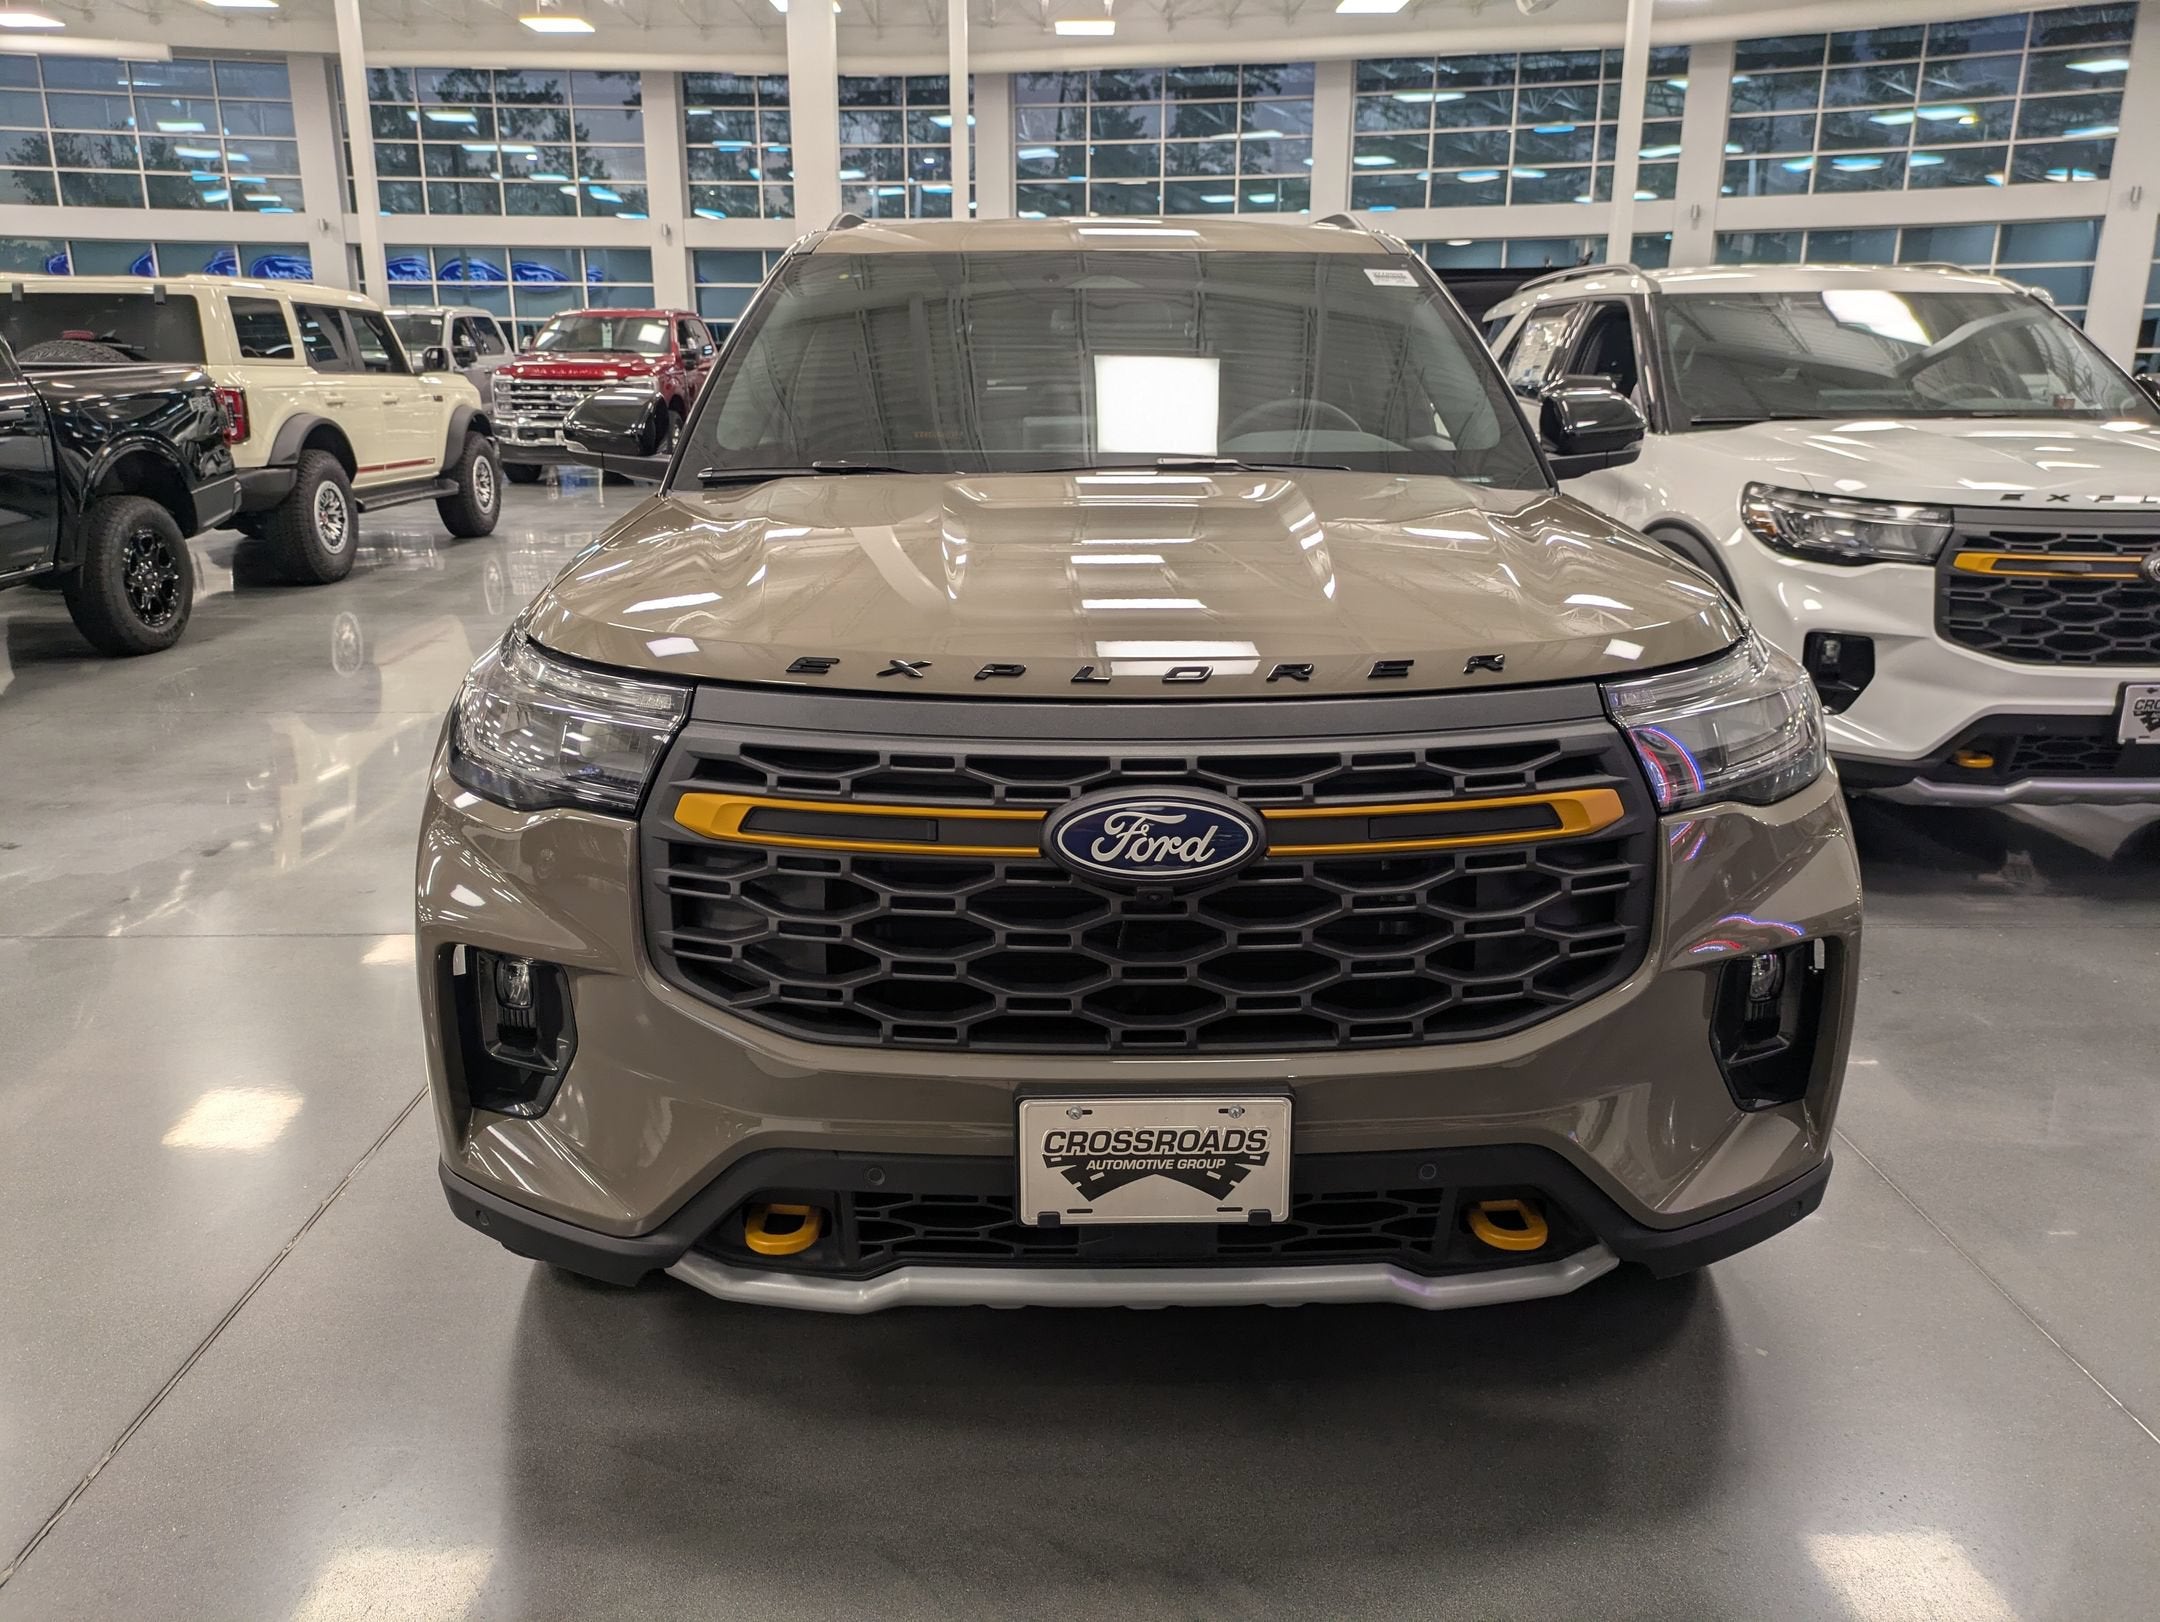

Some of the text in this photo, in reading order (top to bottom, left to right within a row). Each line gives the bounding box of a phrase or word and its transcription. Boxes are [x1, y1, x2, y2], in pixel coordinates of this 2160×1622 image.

[785, 653, 1505, 683] EXPLORER
[1091, 811, 1219, 863] Ford
[1044, 1129, 1268, 1155] CROSSROADS
[1086, 1158, 1226, 1171] AUTOMOTIVE GROUP
